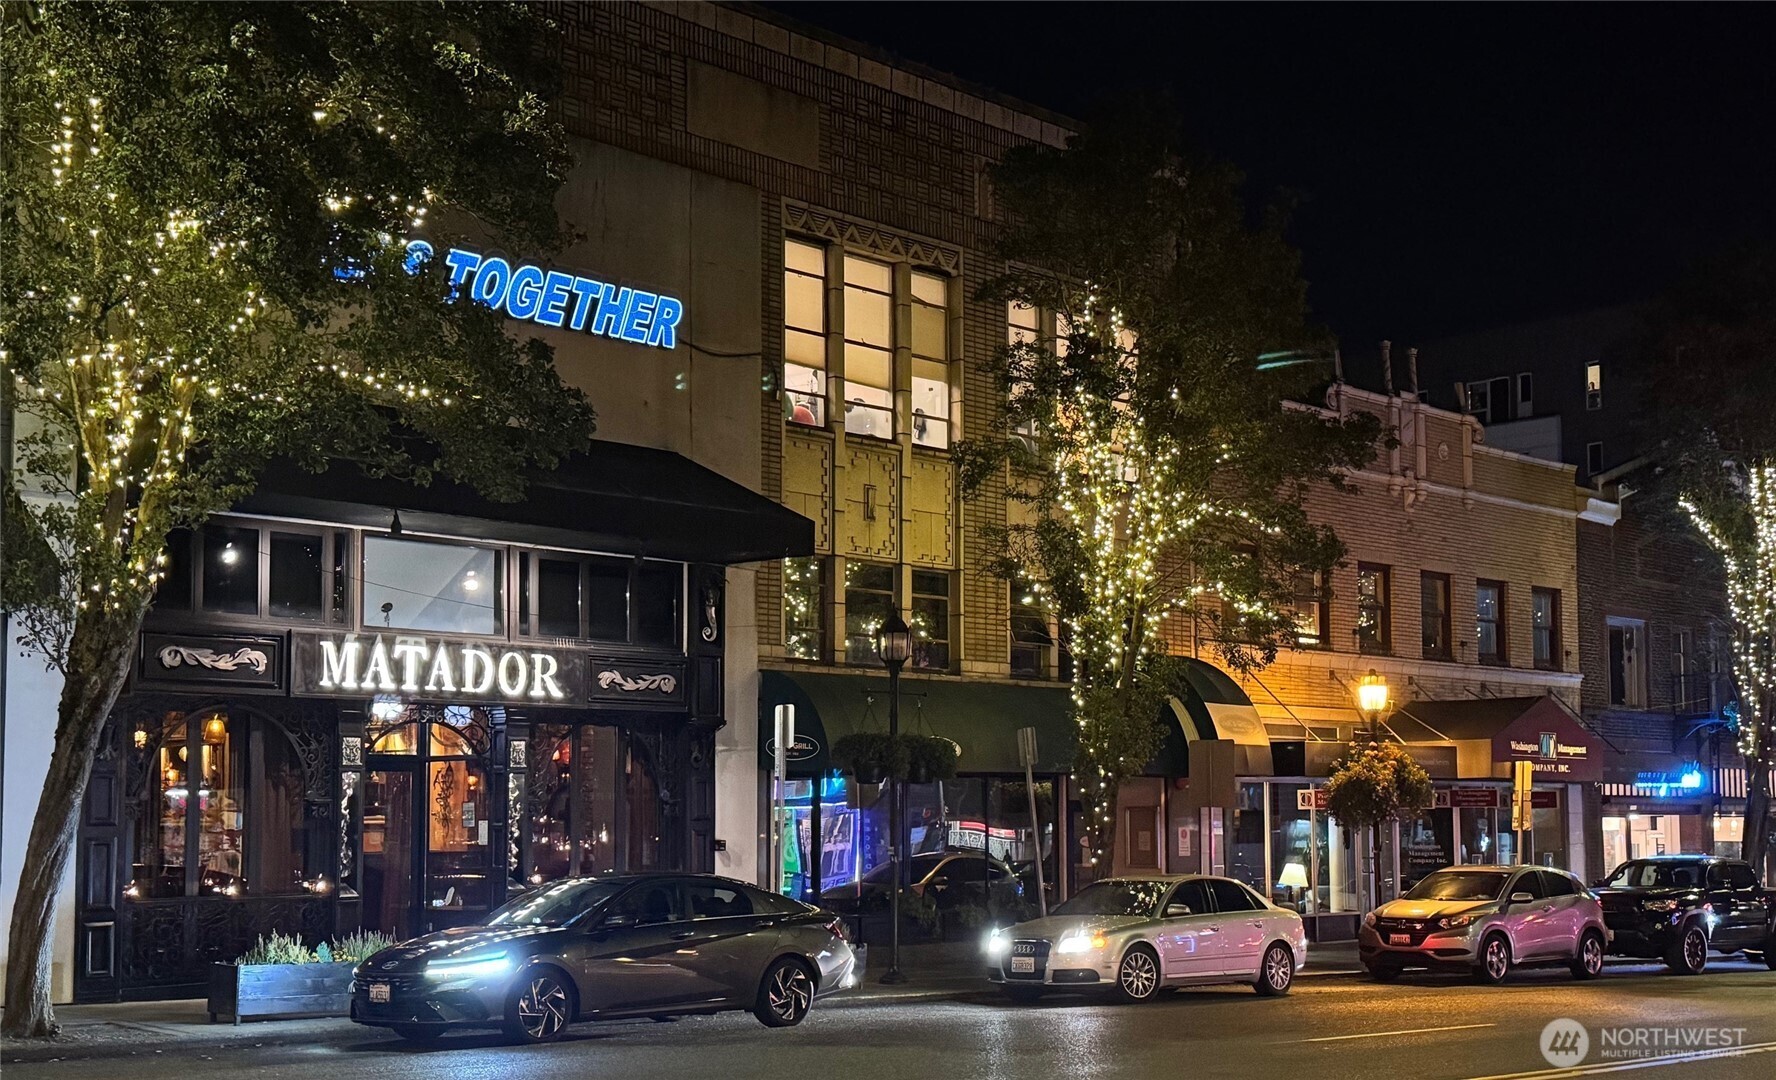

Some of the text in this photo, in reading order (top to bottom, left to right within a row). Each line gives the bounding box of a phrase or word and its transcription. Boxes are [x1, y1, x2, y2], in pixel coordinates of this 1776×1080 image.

[446, 248, 682, 348] TOGETHER
[319, 641, 563, 697] MATADOR
[1510, 740, 1587, 756] Washington Management
[1532, 763, 1557, 773] OMPANY,
